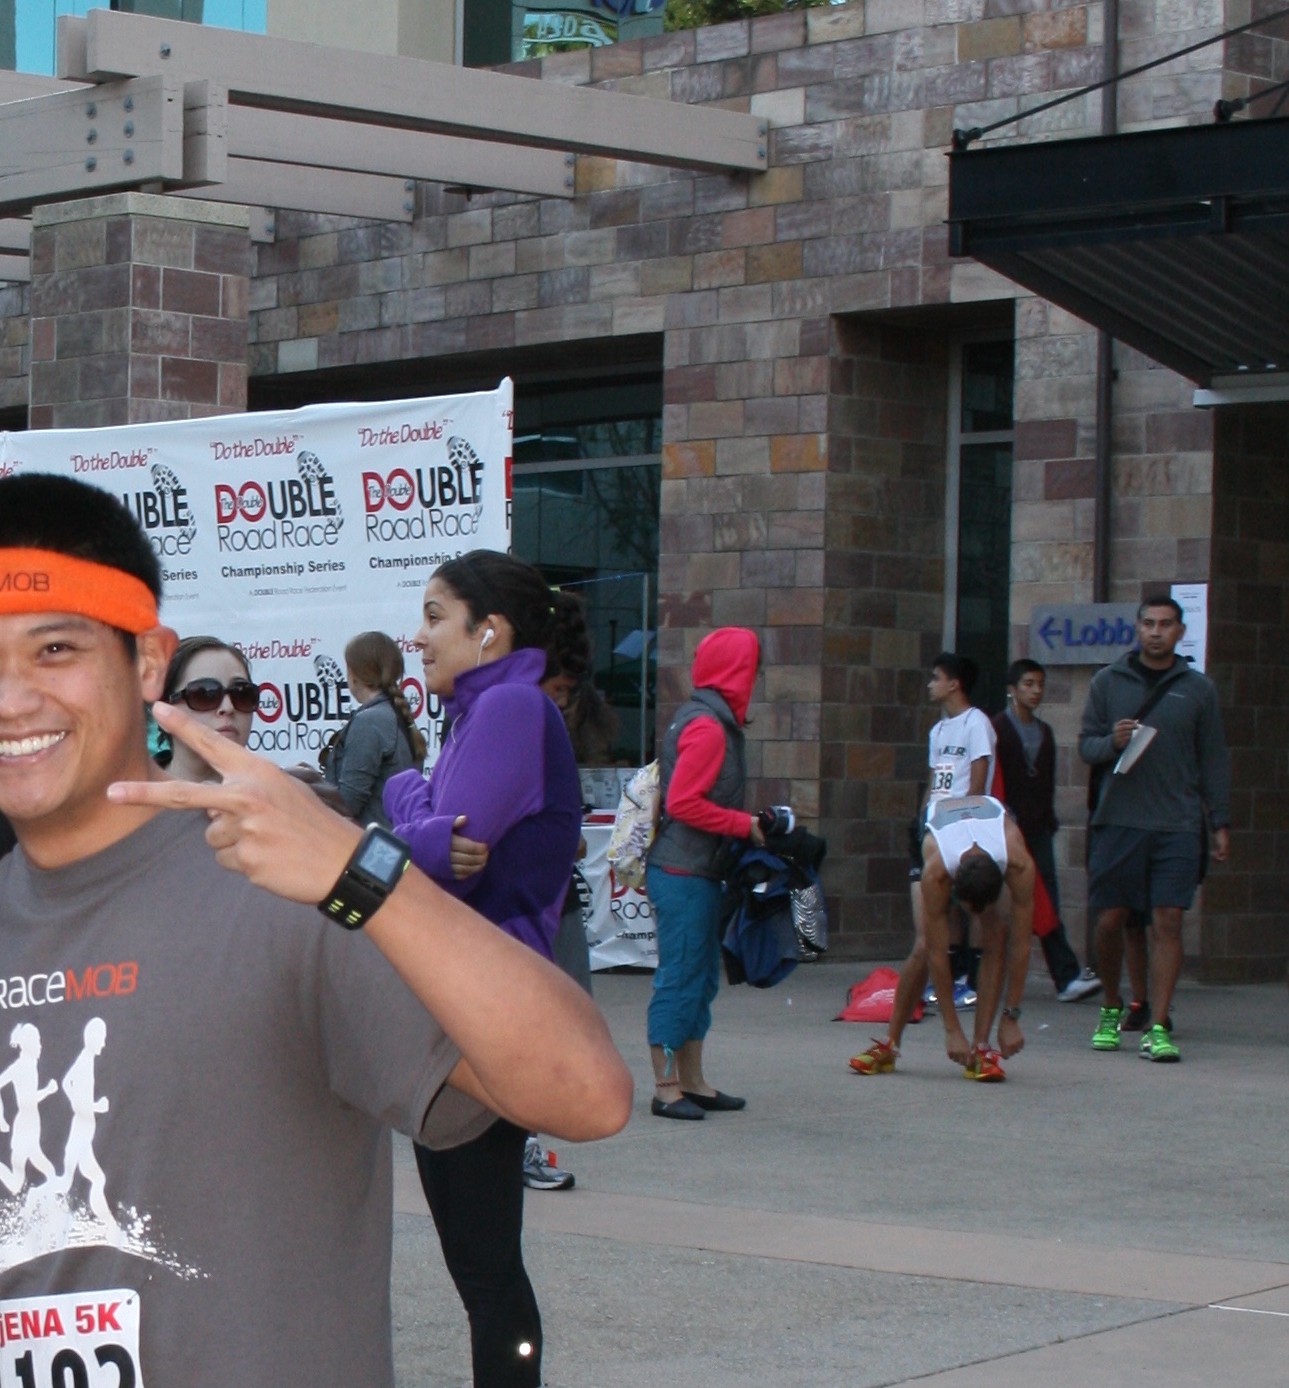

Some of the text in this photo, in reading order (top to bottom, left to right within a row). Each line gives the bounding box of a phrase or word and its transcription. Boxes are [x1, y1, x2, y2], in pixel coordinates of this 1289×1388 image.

[377, 426, 399, 445] the
[233, 440, 254, 458] the
[90, 453, 109, 471] the
[362, 461, 485, 513] DOUBLE
[214, 475, 337, 524] DOUBLE
[217, 519, 339, 552] Road Race
[366, 508, 426, 543] Road
[429, 507, 479, 539] Race
[150, 534, 191, 556] ace
[221, 559, 346, 578] Championship Series
[369, 551, 452, 570] Championship
[162, 568, 198, 581] Series
[1064, 616, 1141, 650] Lobb
[248, 640, 271, 660] the
[257, 681, 351, 724] OUBLE
[246, 722, 331, 752] oad Rac
[610, 899, 654, 921] Roa
[75, 1301, 123, 1335] 5K
